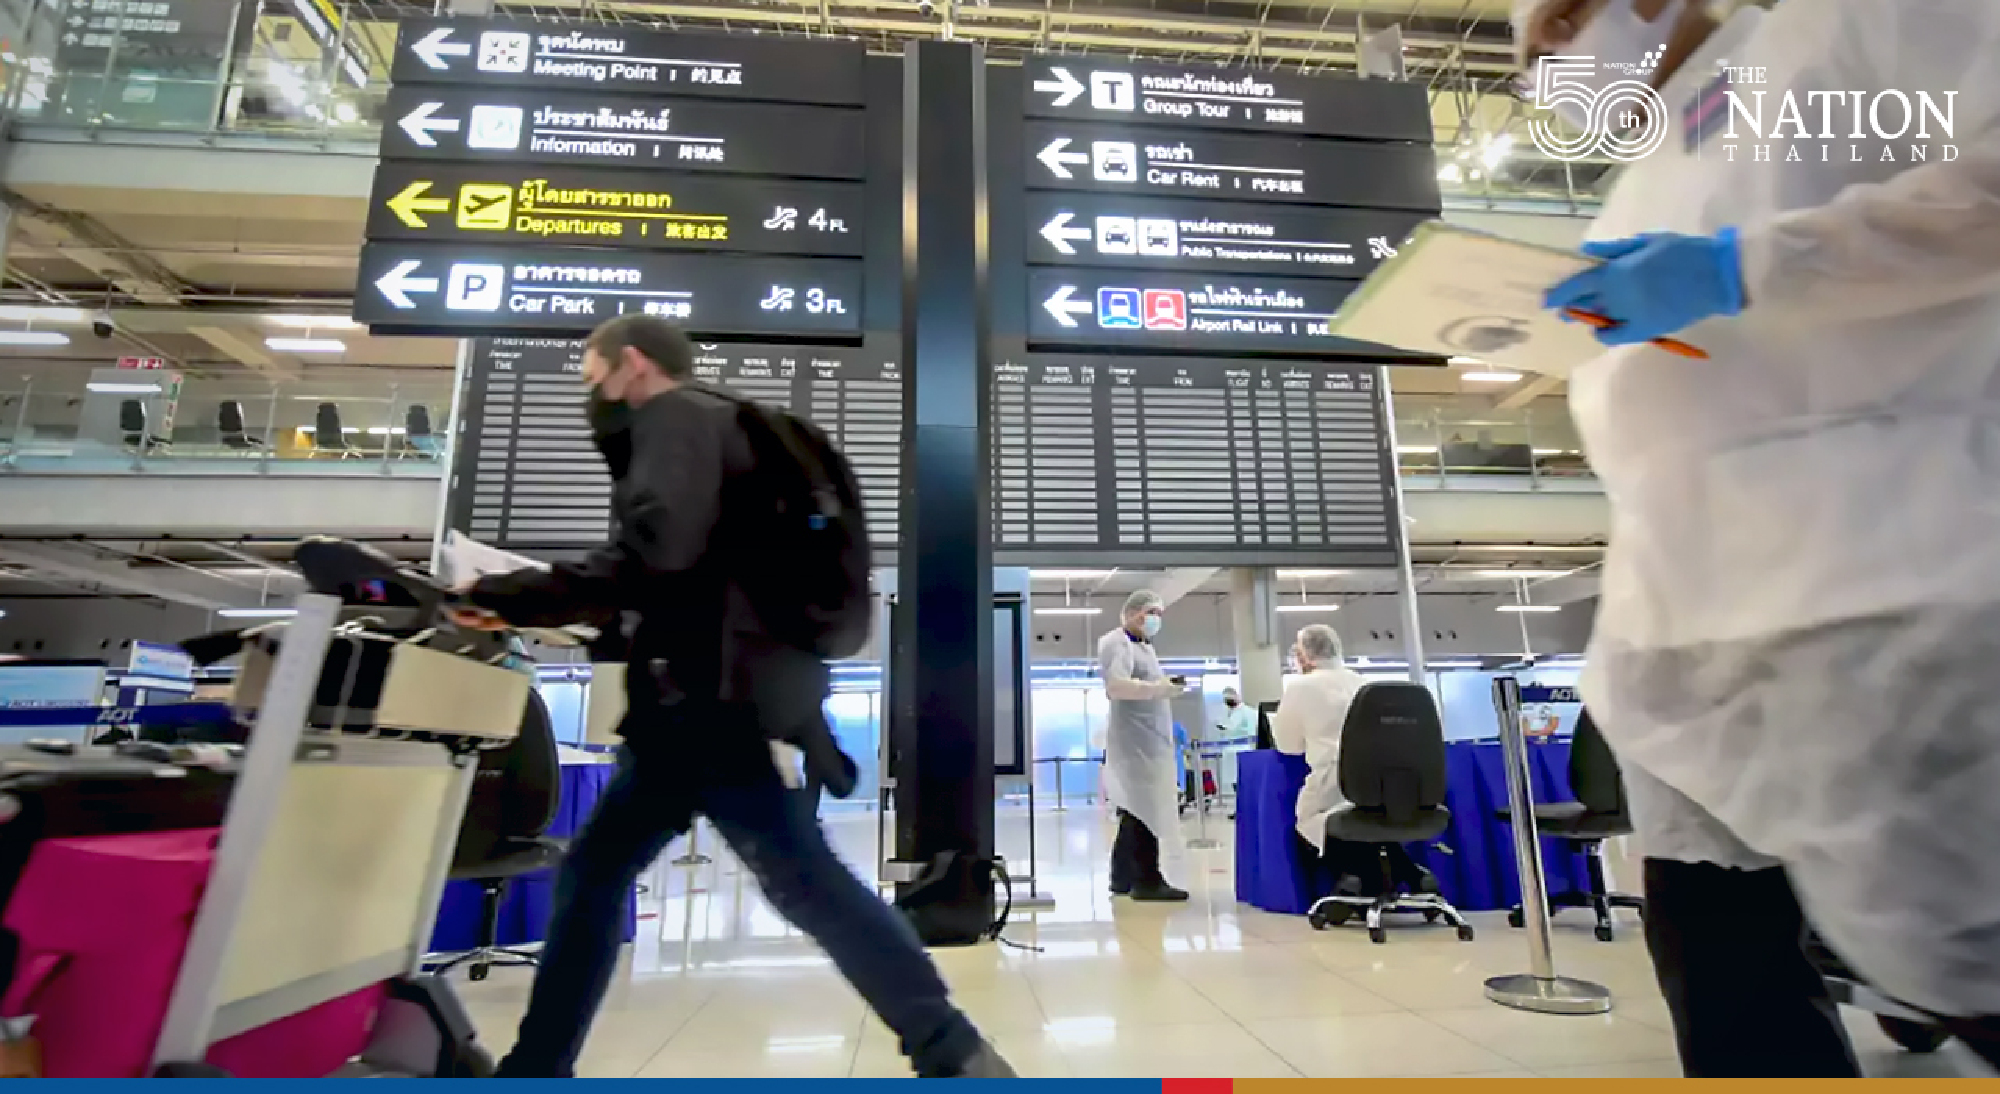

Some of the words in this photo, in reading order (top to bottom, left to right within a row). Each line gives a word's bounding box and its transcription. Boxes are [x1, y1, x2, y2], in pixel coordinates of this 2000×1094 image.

[534, 59, 606, 81] Meeting
[610, 63, 657, 81] Point
[1102, 80, 1123, 105] T
[1143, 97, 1193, 118] Group
[1195, 101, 1231, 118] Tour
[530, 136, 637, 157] Information
[1146, 168, 1178, 186] Car
[1181, 170, 1221, 189] Rent
[515, 215, 624, 237] Departures
[1181, 245, 1213, 258] Public
[462, 273, 488, 301] P
[509, 294, 547, 314] Car
[550, 295, 595, 315] Park
[1190, 317, 1230, 333] Airport
[1232, 318, 1256, 333] Rail
[1258, 319, 1283, 334] Link
